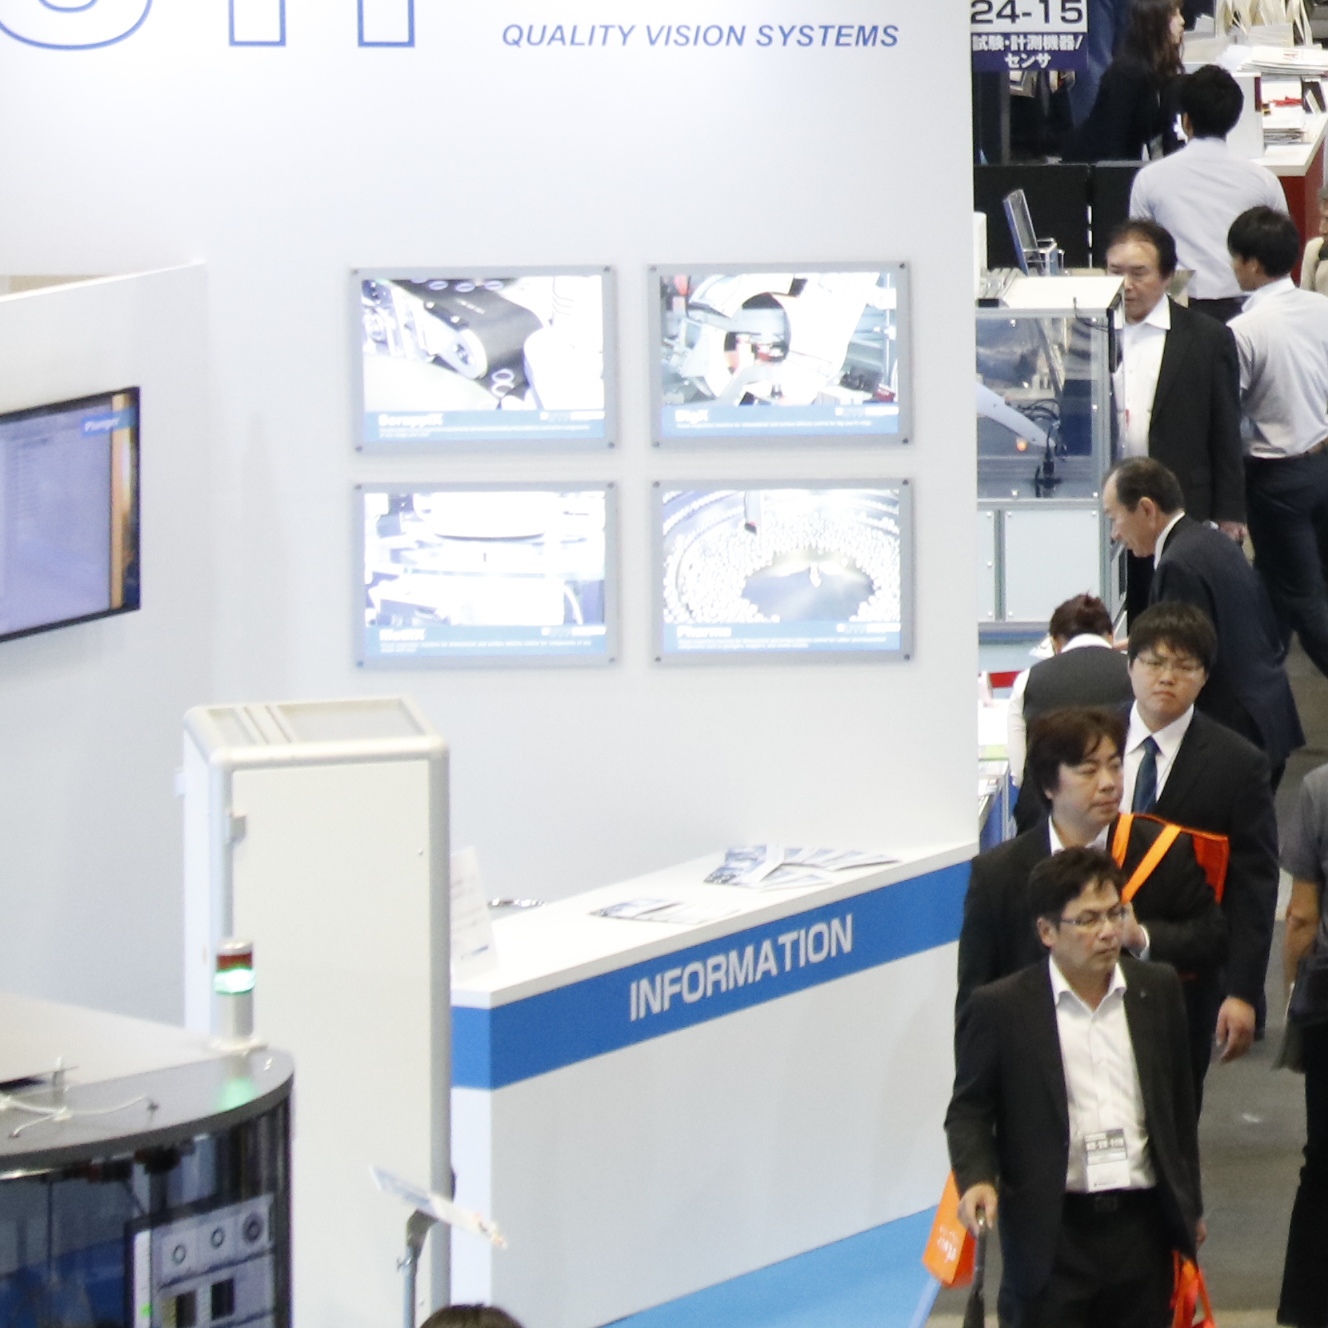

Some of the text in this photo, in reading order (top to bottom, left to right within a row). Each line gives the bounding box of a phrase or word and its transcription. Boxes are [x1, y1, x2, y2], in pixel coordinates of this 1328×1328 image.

[501, 22, 899, 50] QUALITY VISION SYSTEMS
[1004, 51, 1052, 70] センサ
[629, 914, 855, 1023] INFORMATION
